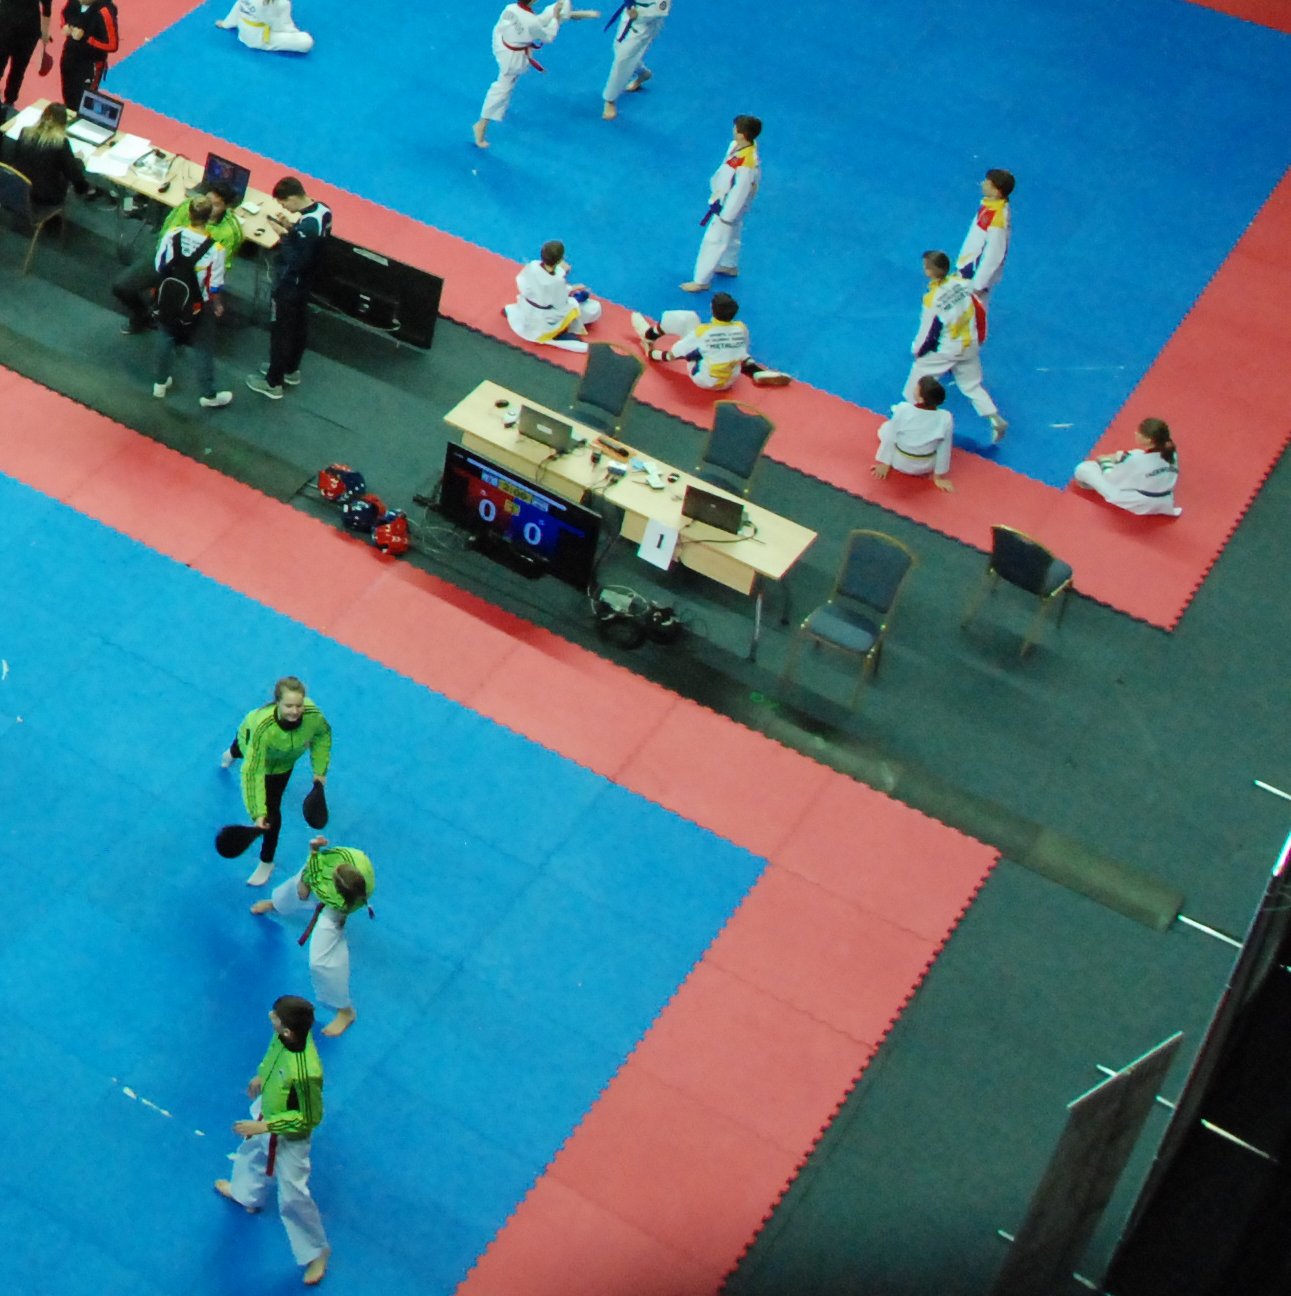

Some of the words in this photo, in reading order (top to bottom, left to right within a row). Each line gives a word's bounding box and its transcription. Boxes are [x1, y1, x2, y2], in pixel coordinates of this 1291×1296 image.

[479, 499, 496, 522] 0
[523, 522, 541, 545] 0
[656, 533, 665, 549] 1
